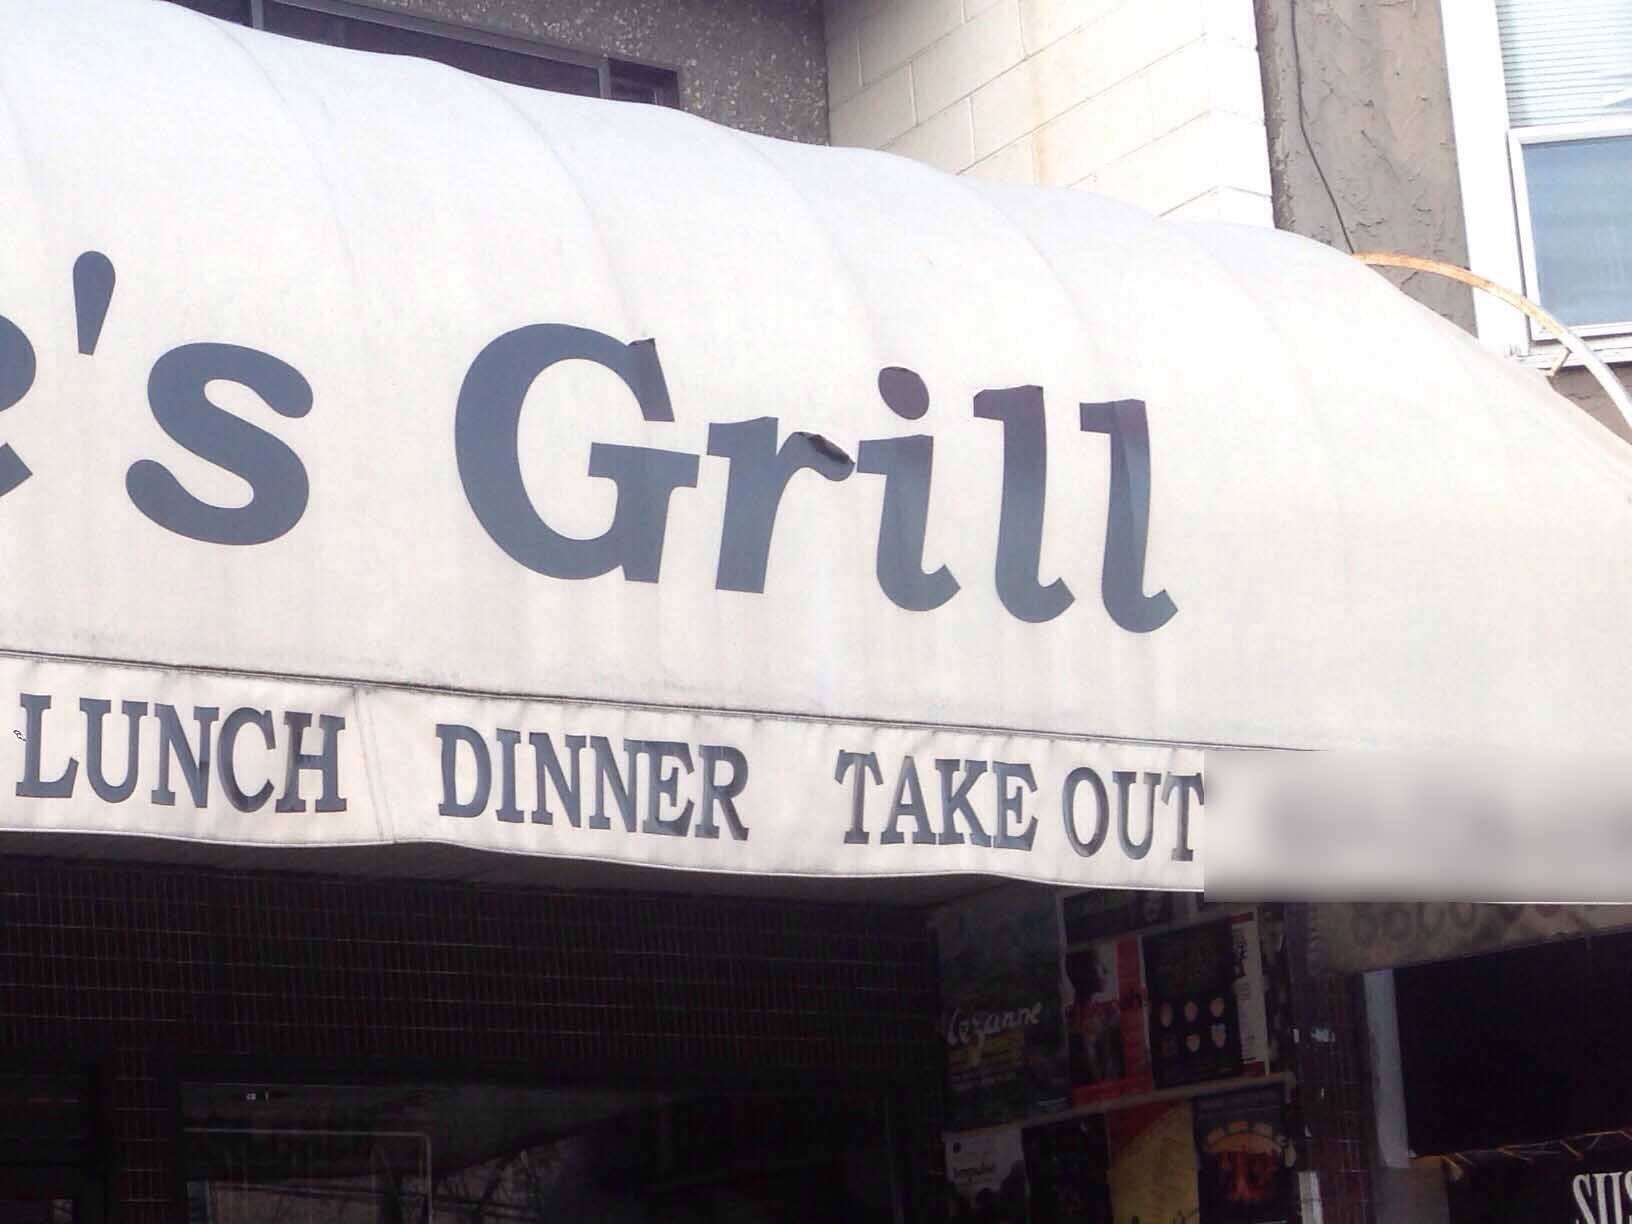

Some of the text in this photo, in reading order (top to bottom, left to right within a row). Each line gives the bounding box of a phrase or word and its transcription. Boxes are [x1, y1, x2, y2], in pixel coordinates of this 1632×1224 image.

[452, 320, 1180, 636] Grill
[15, 692, 349, 816] LUNCH
[435, 722, 751, 842] DINNER
[835, 748, 1040, 851] TAKE
[1062, 765, 1206, 863] OUT
